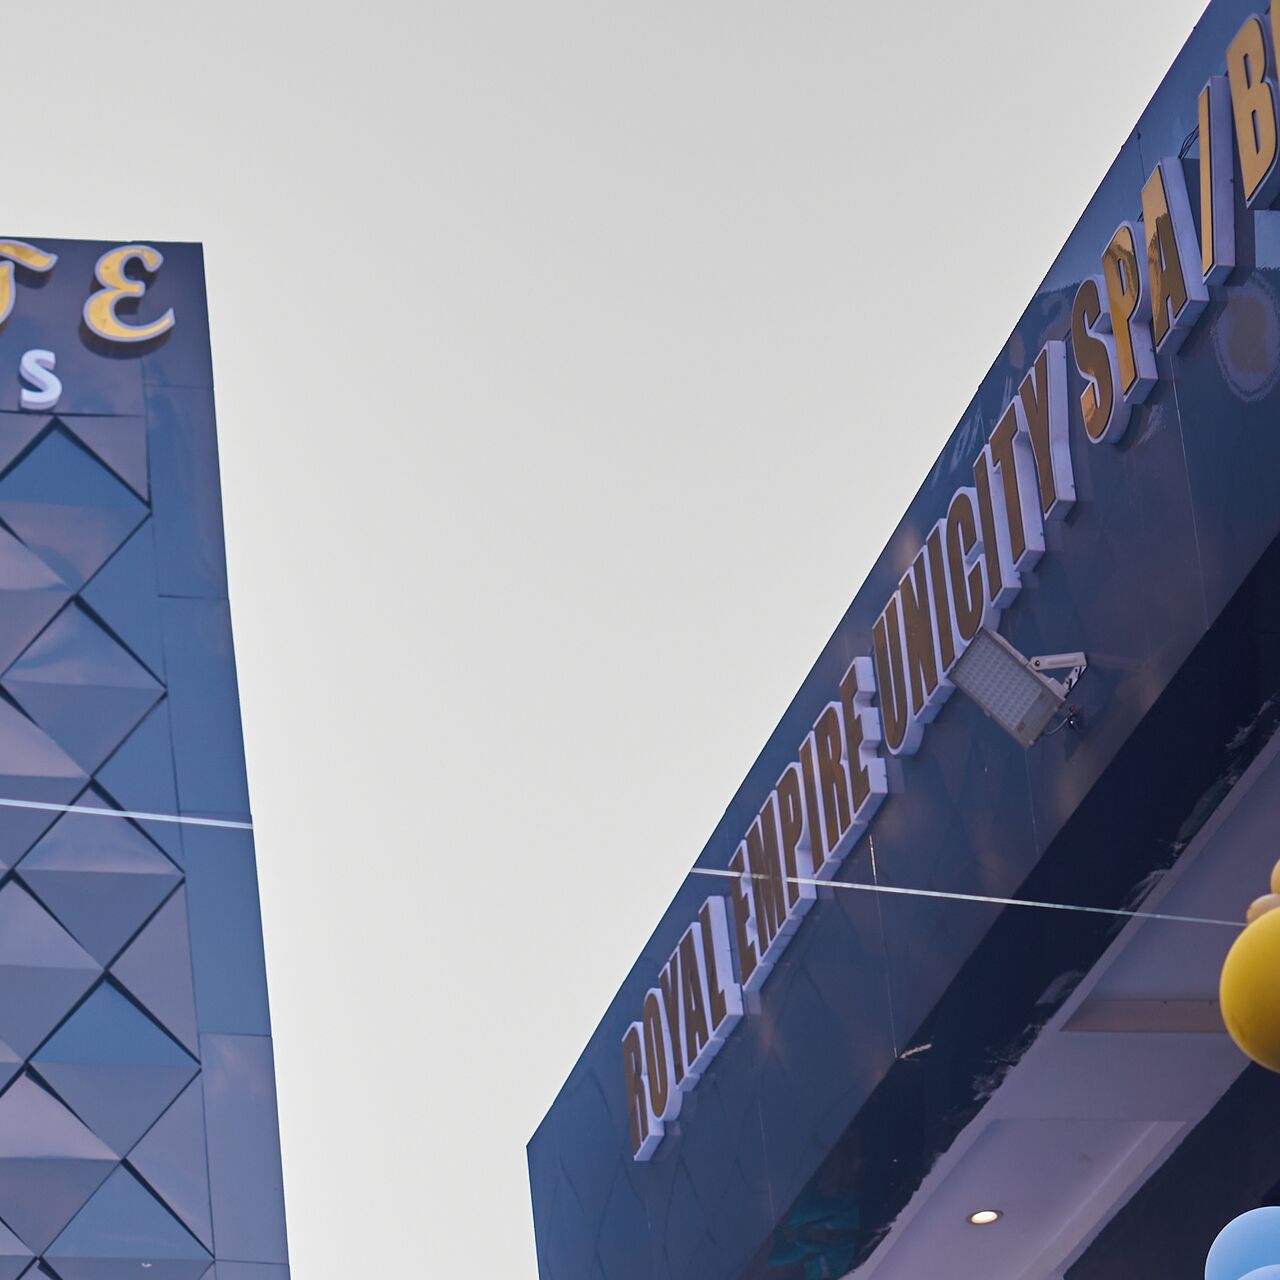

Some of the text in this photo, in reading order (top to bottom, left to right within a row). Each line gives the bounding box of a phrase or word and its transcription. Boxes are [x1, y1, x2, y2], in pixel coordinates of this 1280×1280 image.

[622, 896, 743, 1161] ROYAL
[728, 657, 888, 993] EMPIRE
[872, 340, 1076, 755] UNICITY
